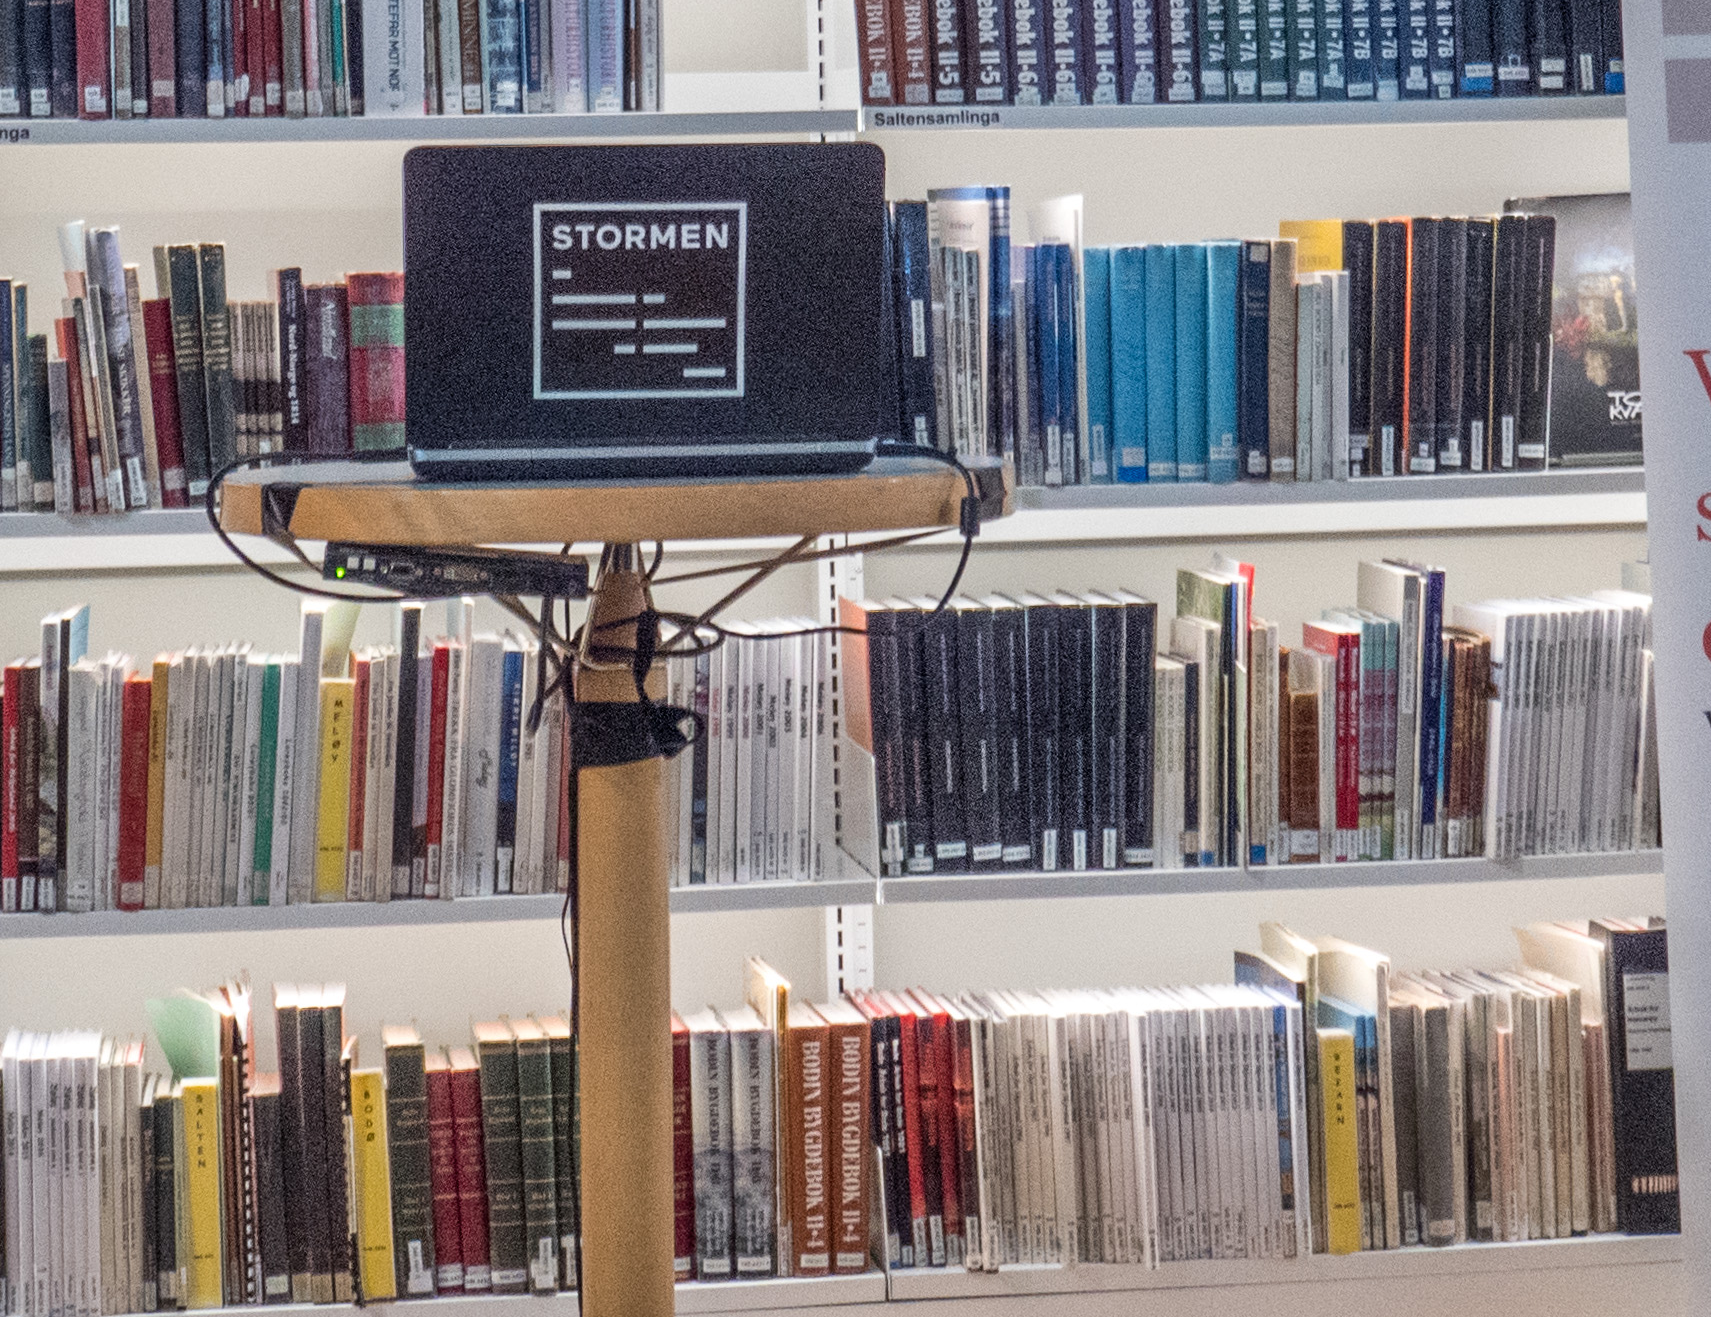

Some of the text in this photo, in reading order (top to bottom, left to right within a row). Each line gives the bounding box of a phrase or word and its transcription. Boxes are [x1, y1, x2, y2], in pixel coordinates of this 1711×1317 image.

[388, 40, 400, 67] MOT
[874, 109, 1001, 128] Saltensamlinga
[551, 223, 730, 252] STORMEN
[287, 323, 298, 385] Nord-Norge
[332, 698, 344, 763] MELØY
[803, 1041, 821, 1101] BODIN
[842, 1037, 861, 1095] BODIN
[196, 1093, 207, 1169] SALTEN
[364, 1089, 376, 1143] BODØ
[804, 1107, 823, 1210] BYGDEBOK
[842, 1102, 861, 1204] BYGDEBOK
